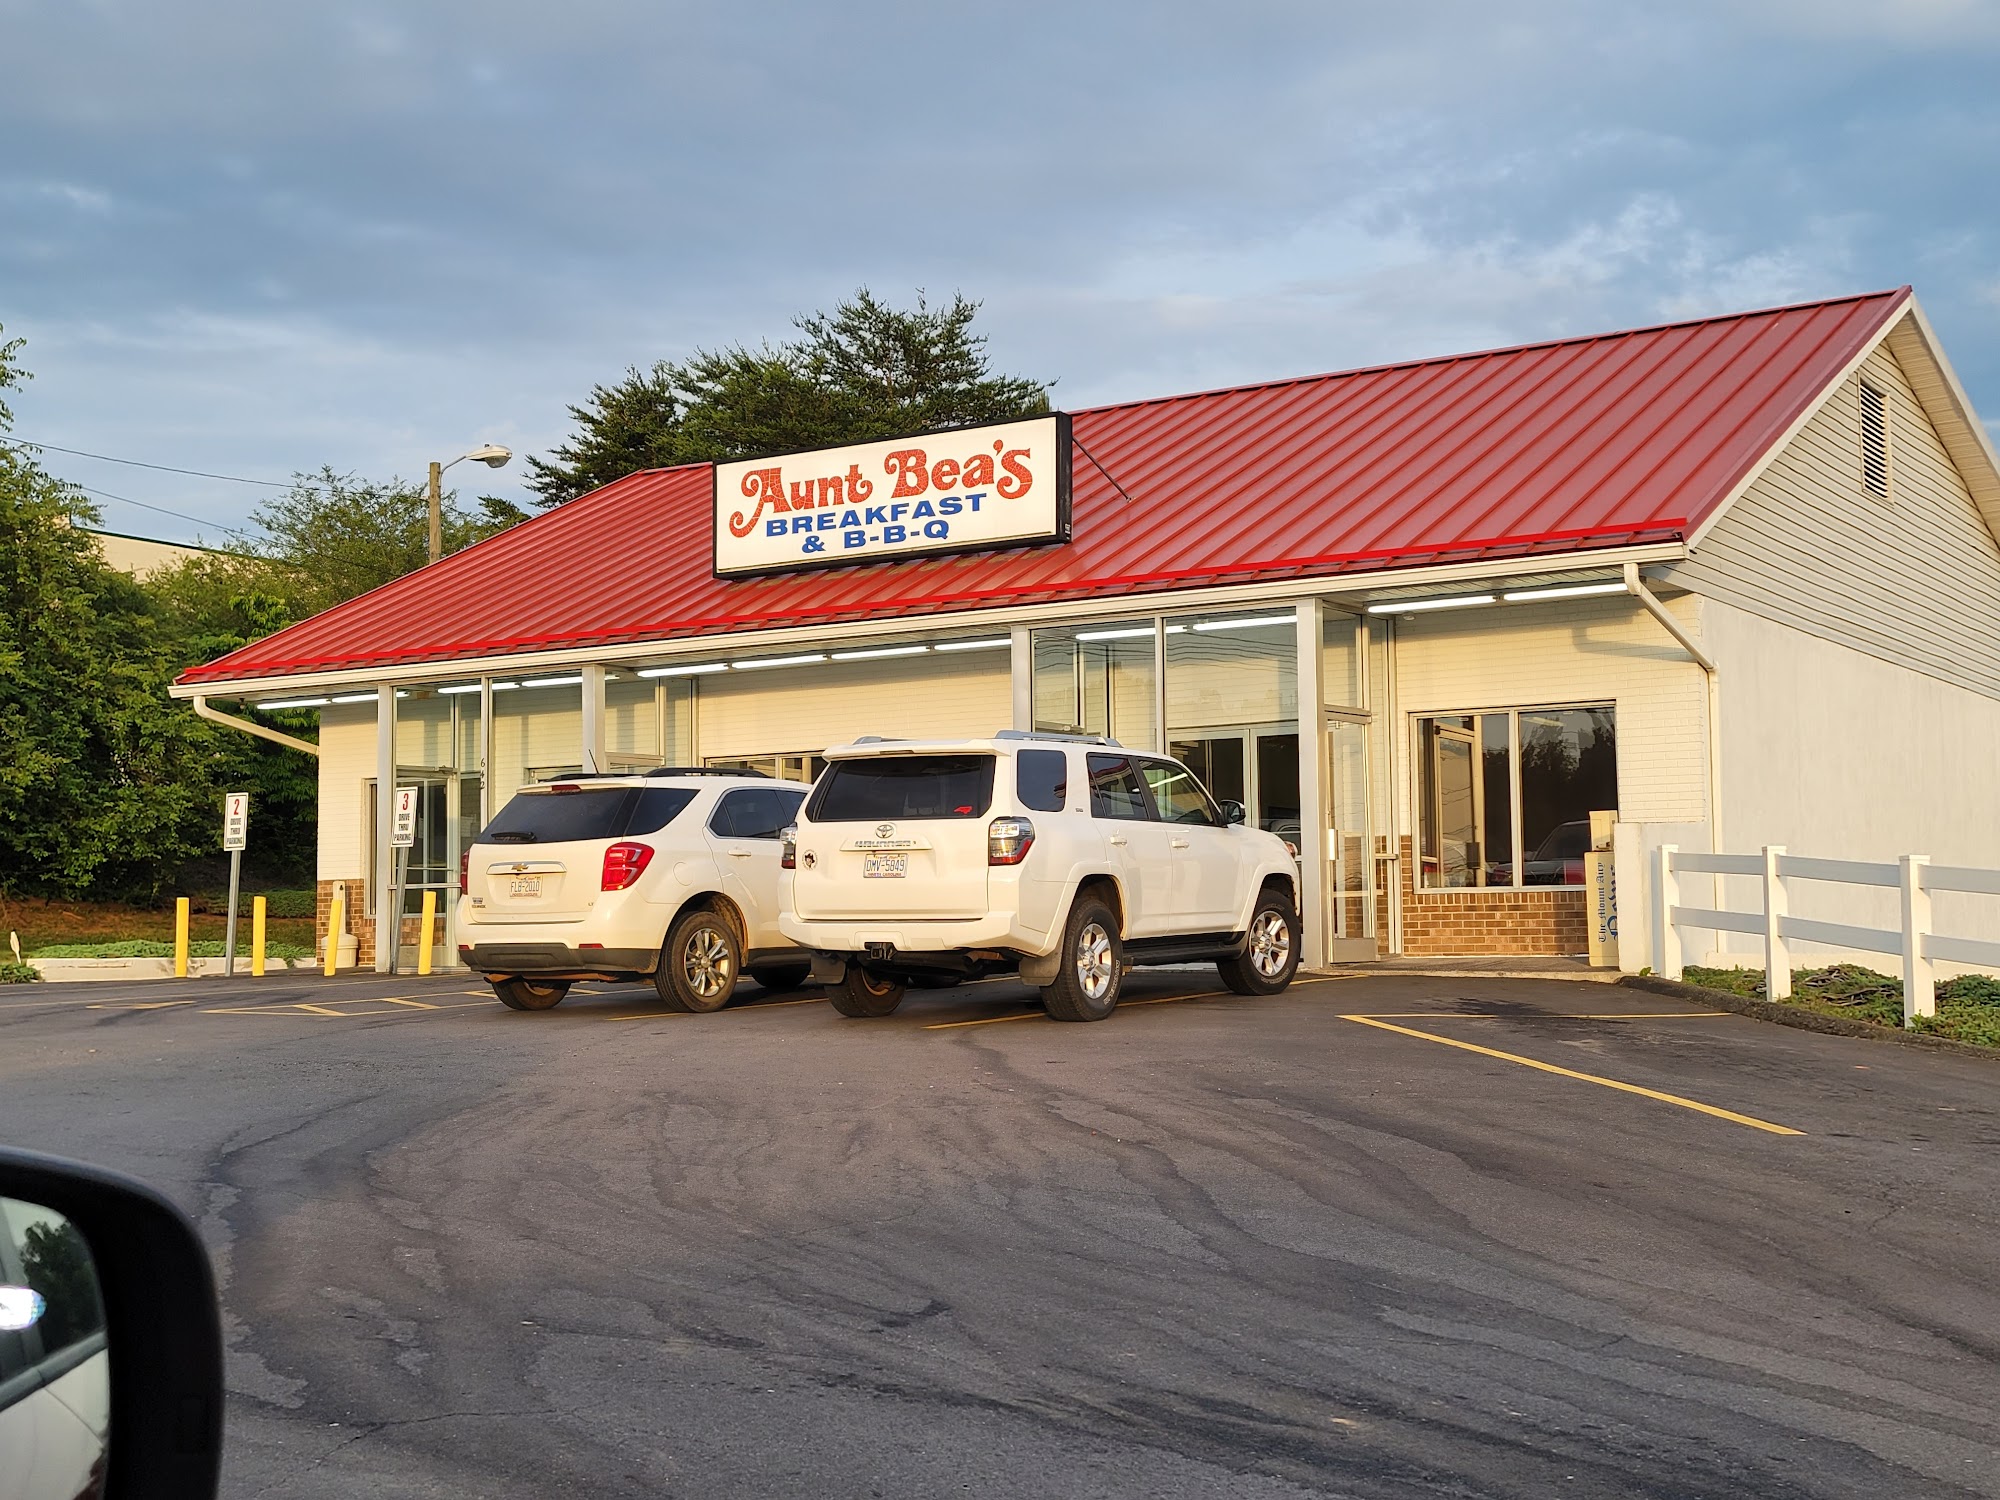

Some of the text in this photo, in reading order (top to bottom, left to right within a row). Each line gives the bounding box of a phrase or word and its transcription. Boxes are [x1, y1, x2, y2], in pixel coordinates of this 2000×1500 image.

[729, 439, 1033, 538] Aunt Bea's
[766, 492, 987, 537] BREAKFAST
[801, 519, 949, 554] & B-B-Q
[233, 798, 240, 815] 2
[402, 793, 409, 811] 3
[230, 817, 242, 826] DRIVE
[398, 813, 410, 822] DRIVE
[230, 827, 241, 835] THRU
[398, 823, 409, 831] THRU
[226, 836, 243, 845] PARKING
[393, 833, 411, 842] PARKING
[1598, 887, 1606, 920] Mount
